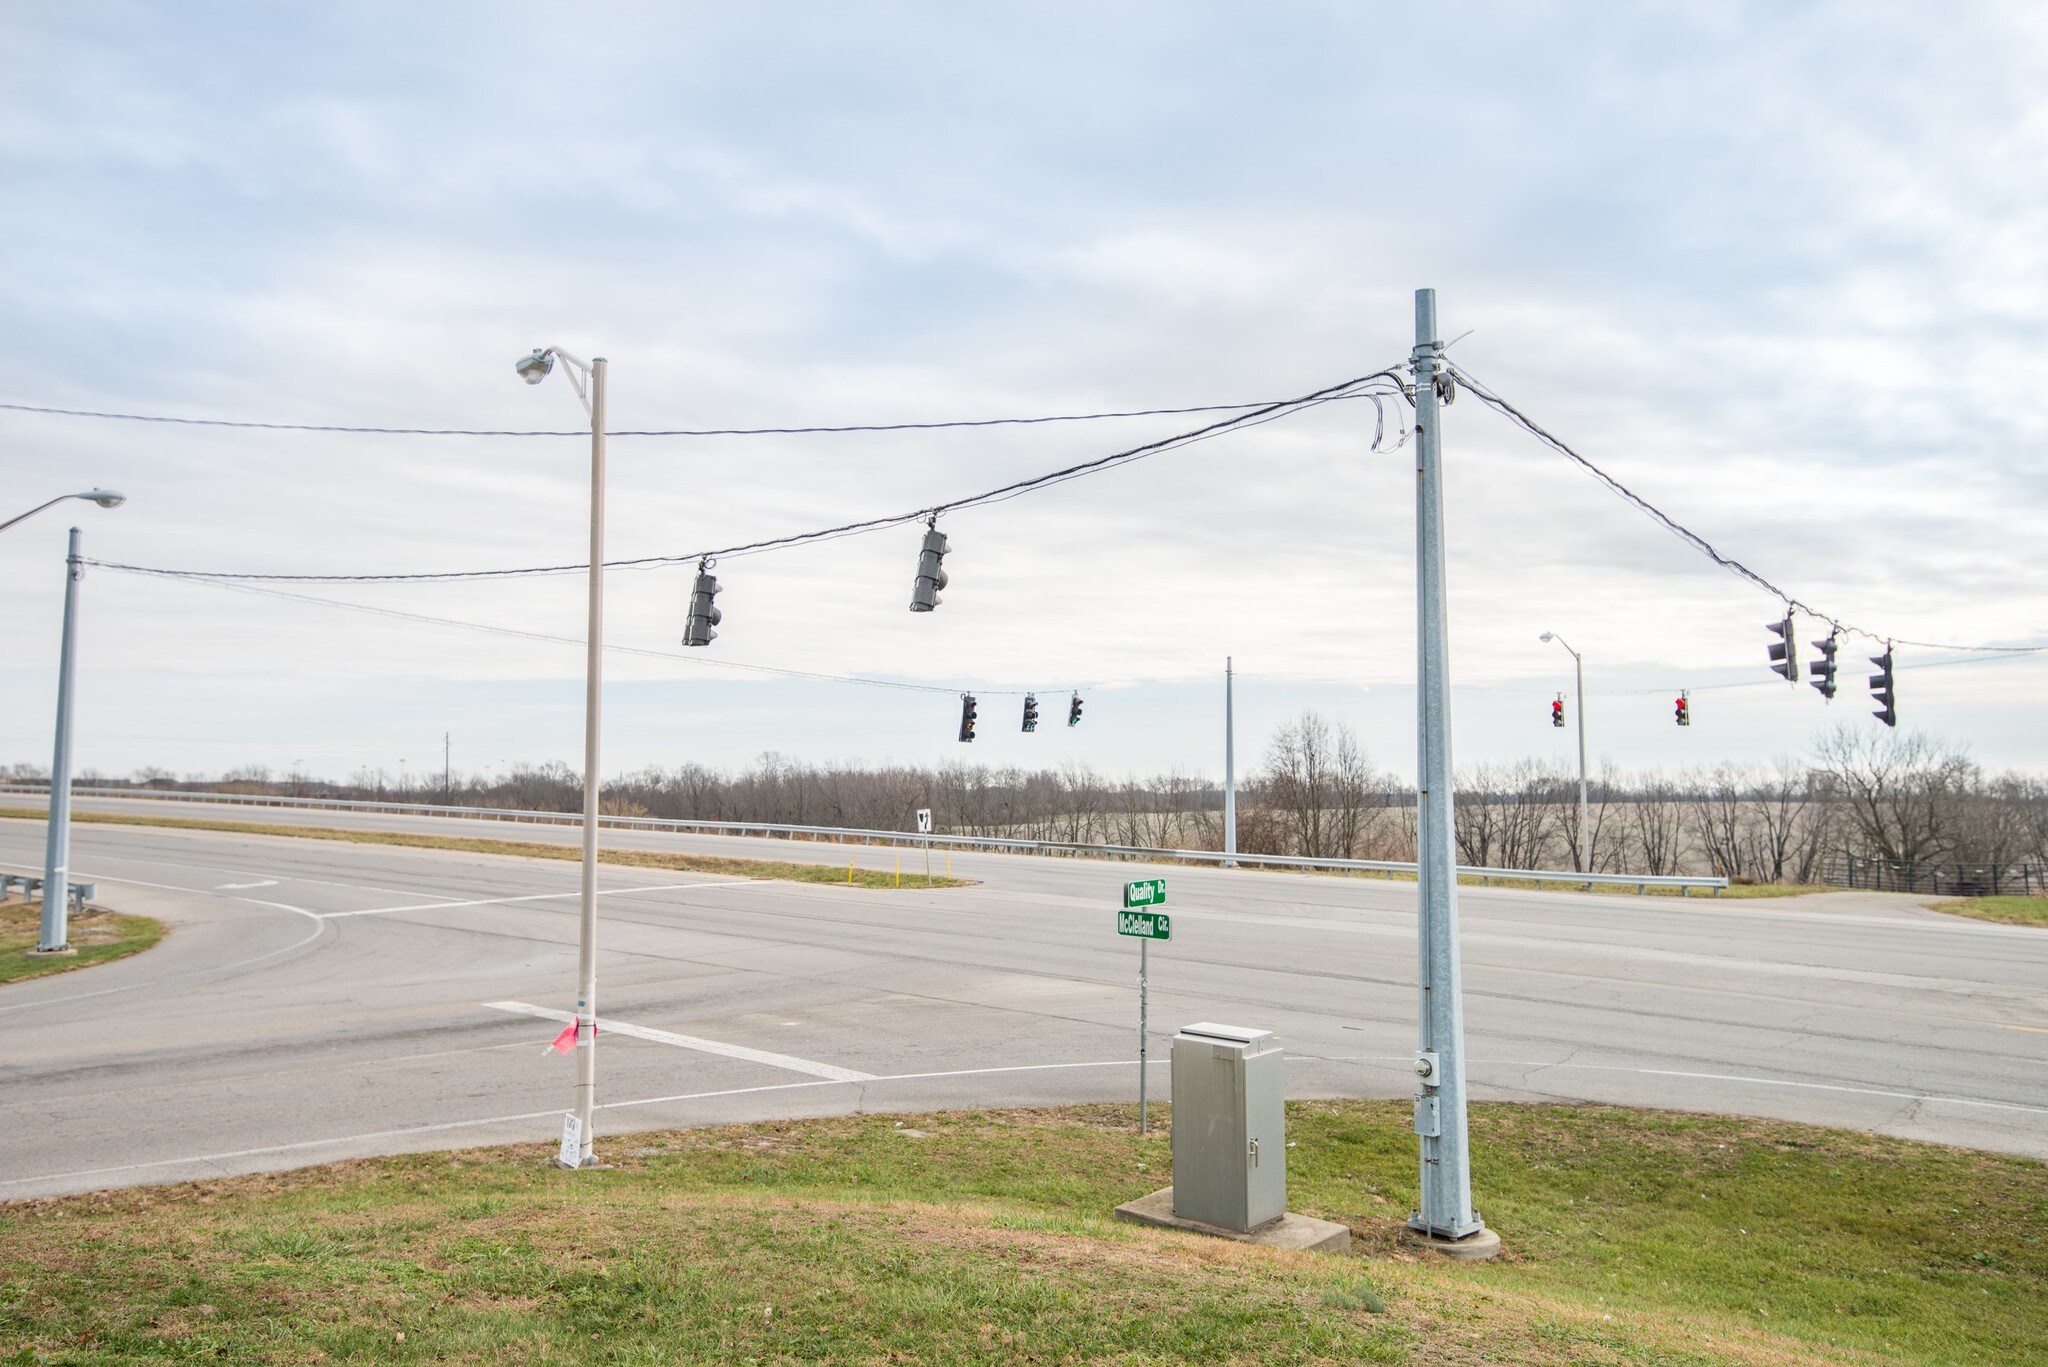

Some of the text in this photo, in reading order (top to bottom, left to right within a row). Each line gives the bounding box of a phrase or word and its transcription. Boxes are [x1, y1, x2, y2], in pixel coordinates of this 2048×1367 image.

[1130, 881, 1155, 903] Quality
[1119, 913, 1169, 936] McClelland Cir.
